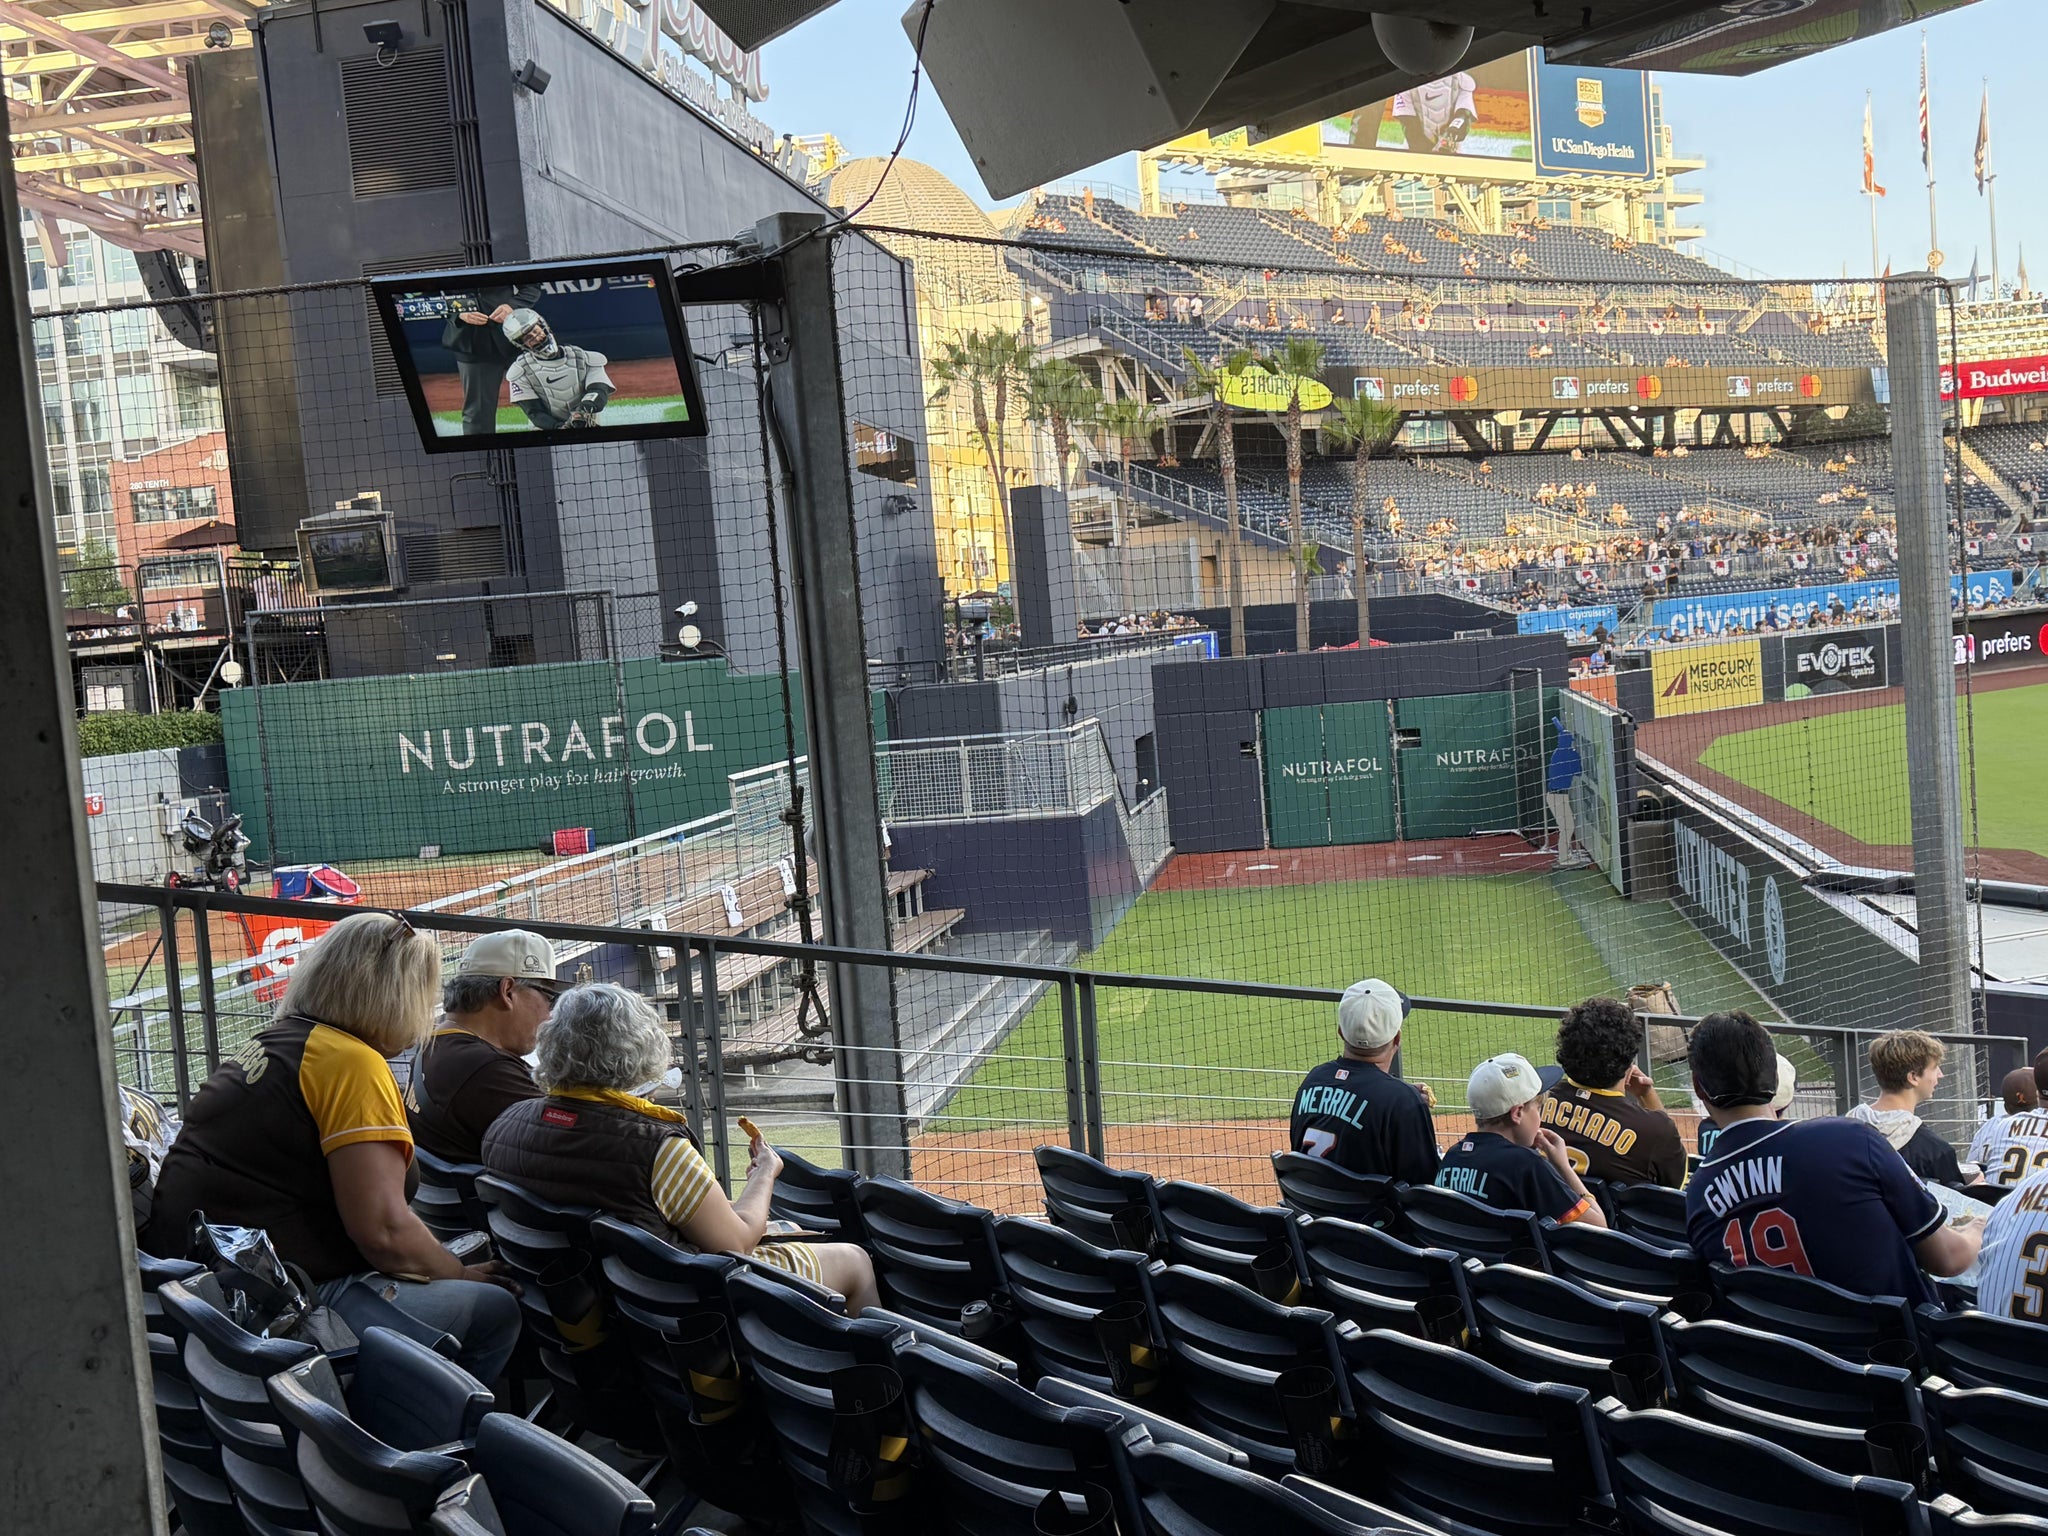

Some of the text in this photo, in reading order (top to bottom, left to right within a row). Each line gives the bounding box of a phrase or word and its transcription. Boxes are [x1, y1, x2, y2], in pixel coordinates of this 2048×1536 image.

[1579, 81, 1600, 93] BEST
[1552, 138, 1635, 159] UC San Diego Health
[1586, 379, 1629, 397] prefers
[1756, 378, 1794, 395] prefers
[1970, 365, 2048, 389] Budwei
[1393, 379, 1440, 401] prefers
[144, 479, 170, 489] TENTH
[1982, 631, 2032, 661] prefers
[1690, 657, 1755, 680] MERCURY
[1691, 675, 1756, 694] INSURANCE
[398, 710, 714, 774] NUTRAFOL
[1282, 757, 1383, 778] NUTRAFOL
[1436, 747, 1539, 767] NUTRAFOL
[442, 762, 687, 795] A stronger play for hair growth.
[1298, 1085, 1369, 1131] MERRILL
[1541, 1097, 1637, 1156] ACHADO
[1303, 1128, 1338, 1158] 7
[1434, 1167, 1489, 1200] MERRILL
[1703, 1155, 1783, 1218] GWYNN
[1723, 1207, 1816, 1278] 19
